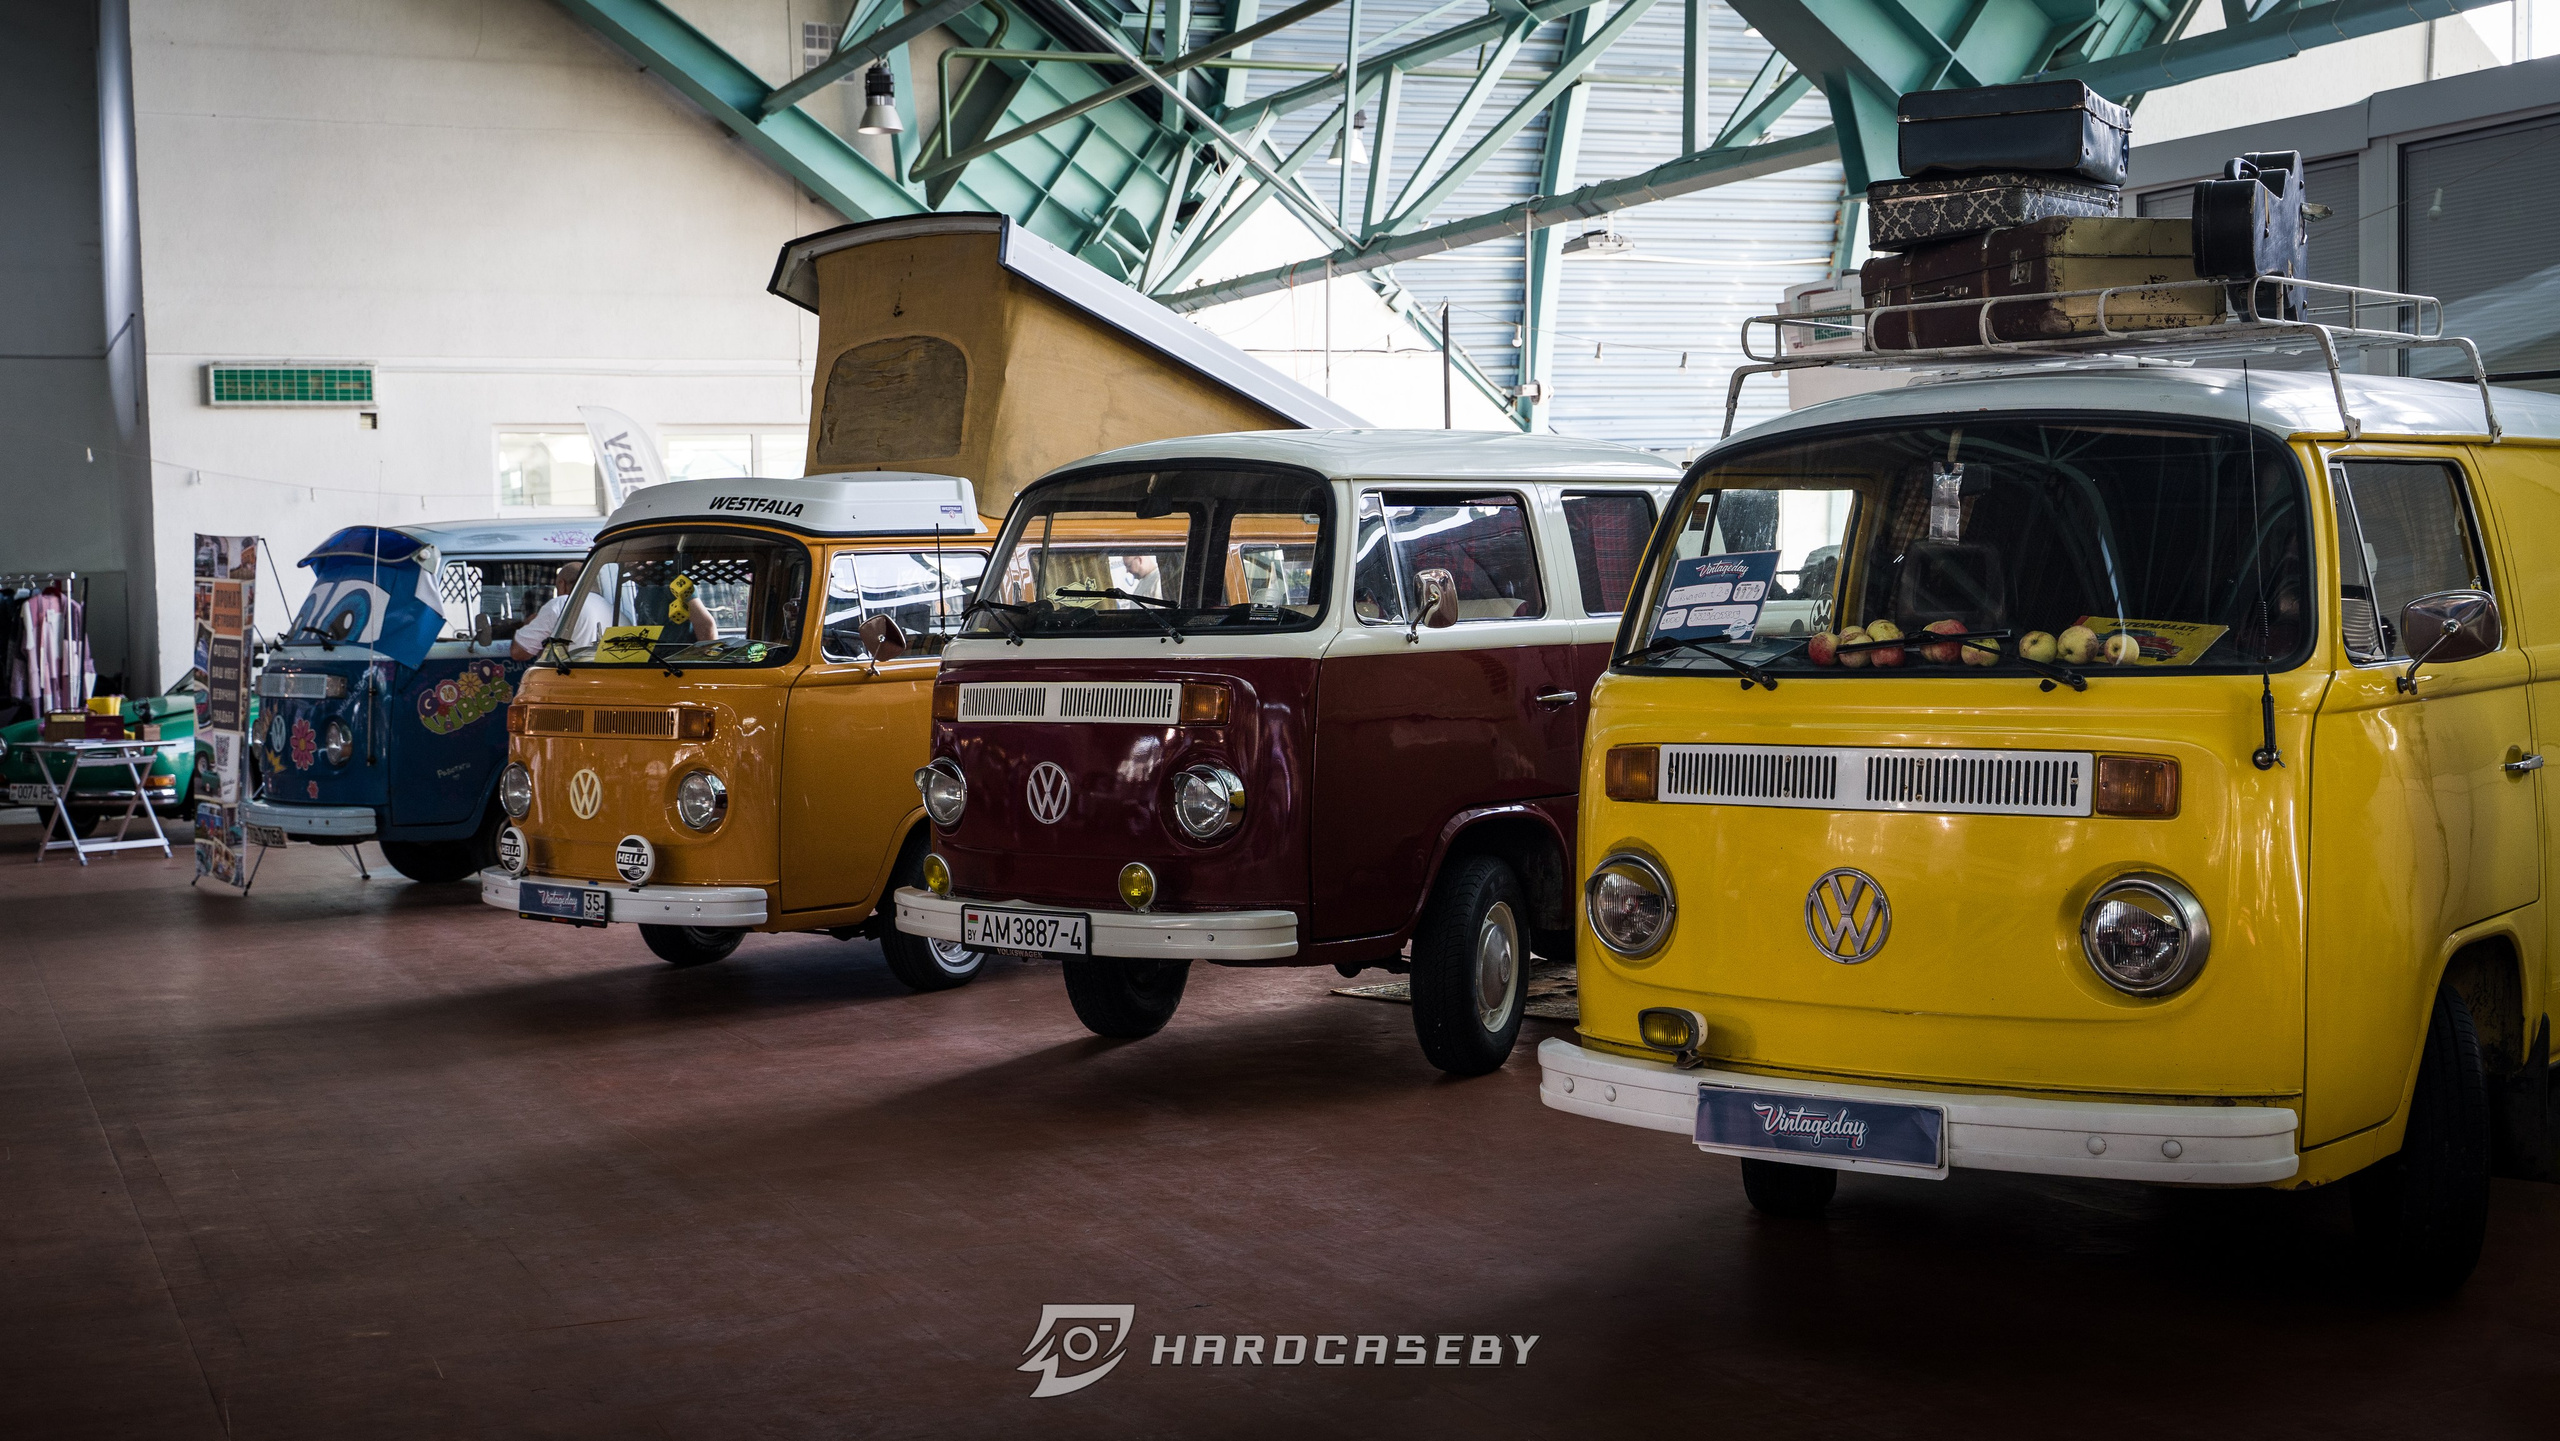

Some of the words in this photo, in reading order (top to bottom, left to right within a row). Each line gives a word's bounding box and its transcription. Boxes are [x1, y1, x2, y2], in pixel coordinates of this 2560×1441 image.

[709, 496, 804, 518] WESTFALIA
[1696, 560, 1749, 579] Vintageday
[2107, 621, 2201, 632] AUTOPARAATI
[569, 769, 603, 819] VW
[1026, 761, 1072, 825] VW
[501, 844, 520, 856] HELLA
[617, 852, 648, 865] HELLA
[538, 889, 578, 912] Vintageday
[585, 893, 600, 911] 35
[1804, 867, 1892, 965] VW
[967, 929, 977, 941] BY
[981, 914, 1083, 950] AM3887-4
[997, 948, 1043, 958] VOLKSWAGEN
[1752, 1101, 1869, 1151] Vintageday
